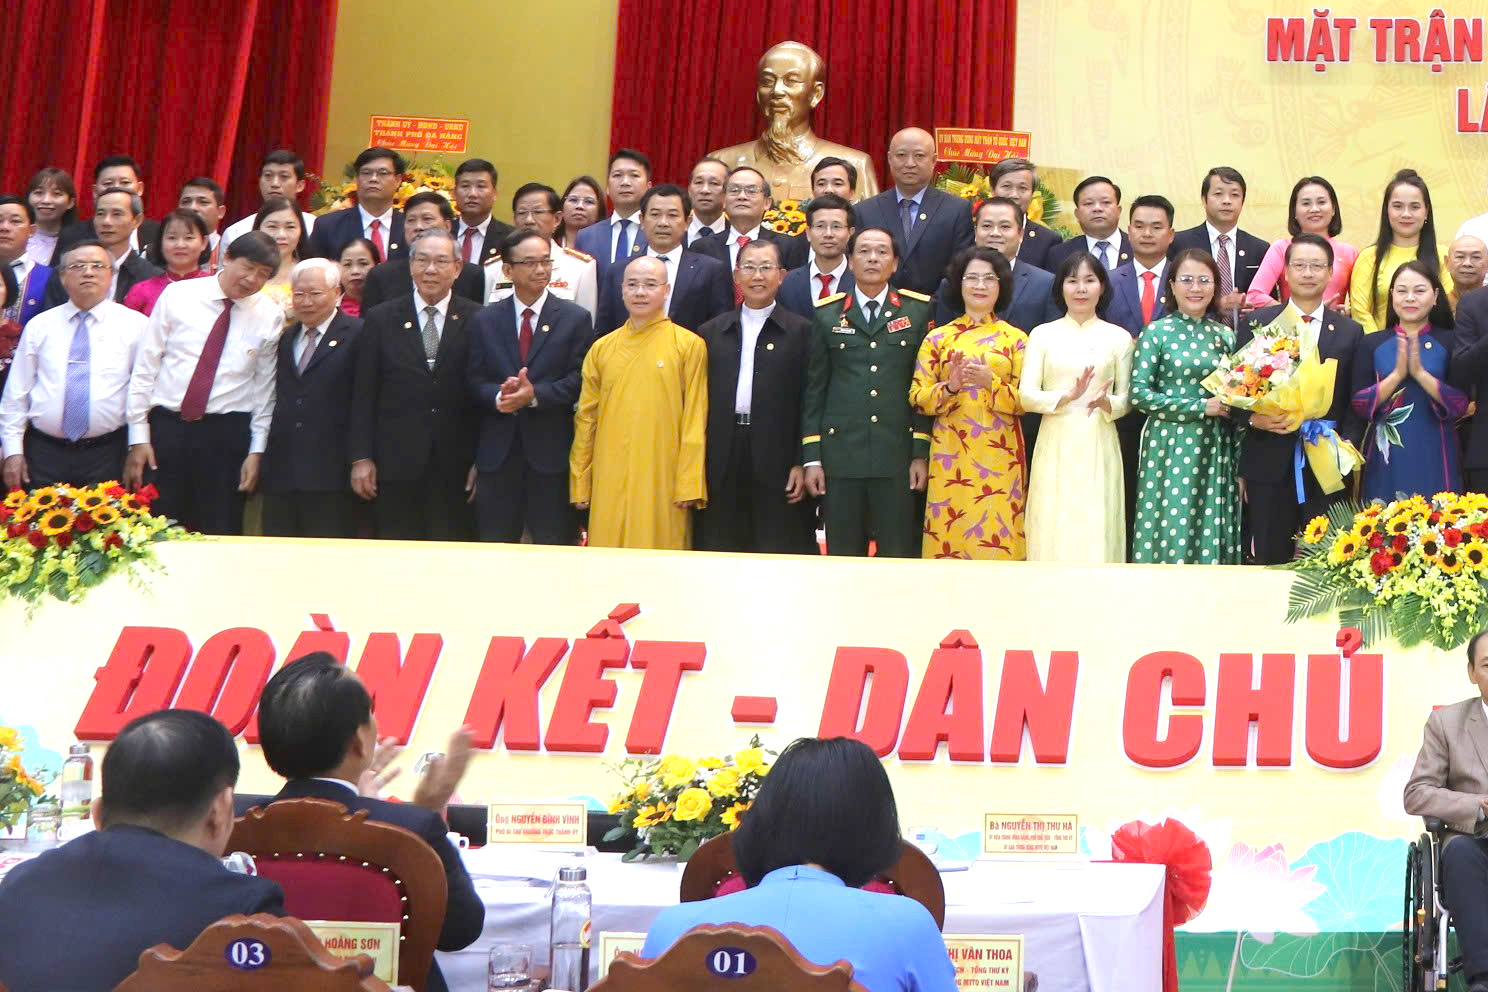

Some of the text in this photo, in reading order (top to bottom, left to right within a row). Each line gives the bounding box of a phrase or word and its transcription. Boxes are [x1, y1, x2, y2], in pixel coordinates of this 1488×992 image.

[1267, 9, 1357, 71] MẶT
[1370, 9, 1483, 72] TRẬN
[463, 603, 707, 755] KẾT
[818, 629, 1079, 765] DÂN
[1122, 627, 1384, 769] CHỦ
[231, 941, 265, 966] 03
[713, 951, 747, 974] 01
[947, 948, 959, 962] HỊ
[986, 948, 1013, 960] THOA
